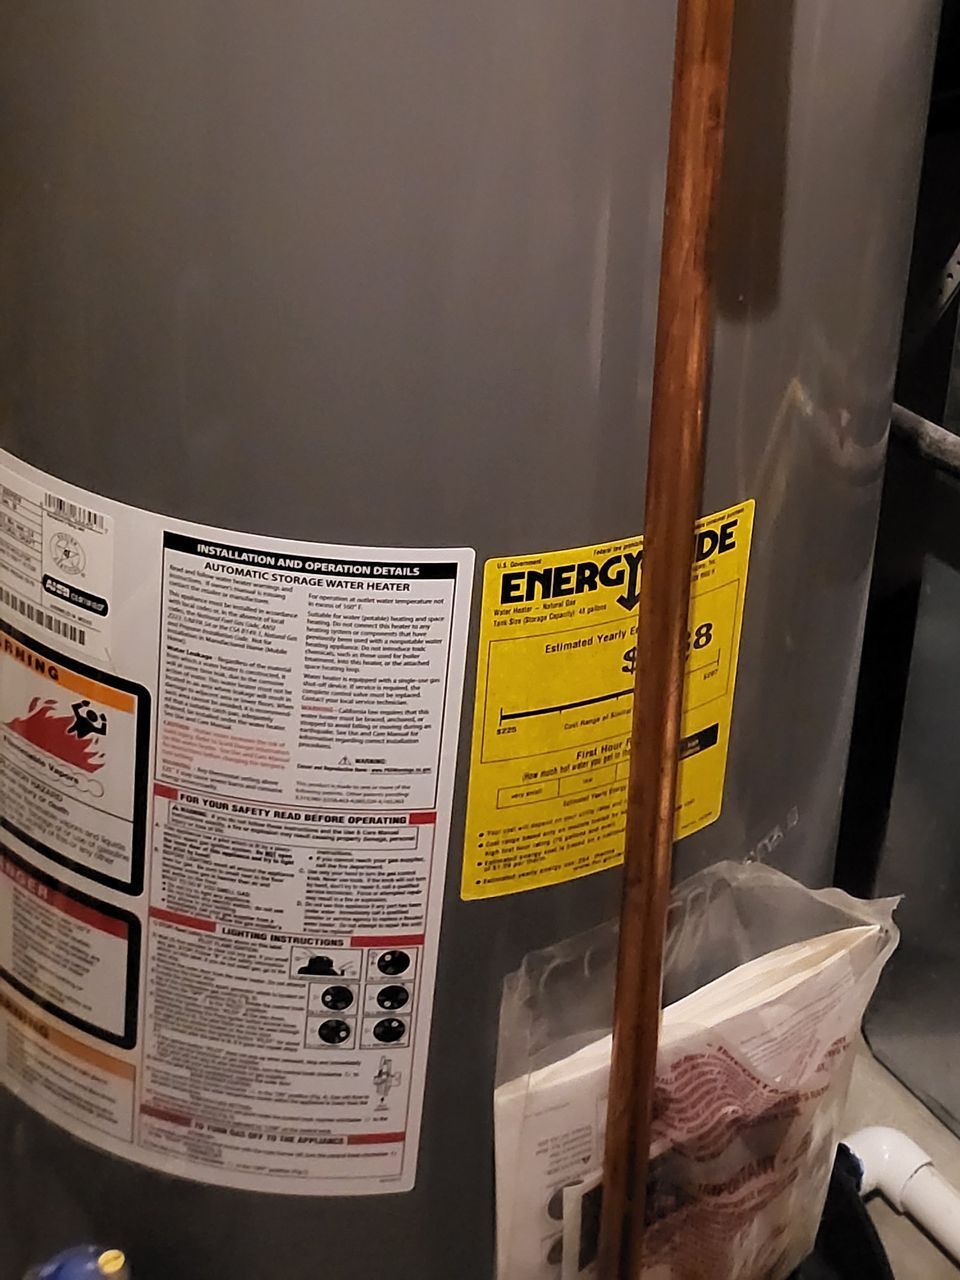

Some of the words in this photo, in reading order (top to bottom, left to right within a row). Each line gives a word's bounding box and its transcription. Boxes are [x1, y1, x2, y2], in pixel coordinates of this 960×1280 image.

[197, 544, 276, 565] INSTALLATION
[277, 557, 302, 569] AND
[305, 561, 372, 576] OPERATION
[374, 566, 420, 576] DETAILS
[204, 562, 269, 581] AUTOMATIC
[272, 573, 324, 587] STORAGE
[326, 580, 364, 590] WATER
[367, 582, 410, 592] HEATER
[494, 608, 511, 616] Water
[513, 606, 532, 615] Heater
[494, 619, 507, 627] Tank
[509, 616, 521, 625] Size
[545, 636, 593, 653] Estimated
[596, 628, 626, 644] Yearly
[576, 748, 597, 759] First
[601, 743, 622, 753] Hour
[180, 793, 199, 805] FOR
[202, 798, 229, 810] YOUR
[232, 804, 271, 817] SAFETY
[273, 811, 301, 820] READ
[304, 813, 344, 824] BEFORE
[348, 815, 407, 824] OPERATING
[222, 927, 267, 941] LIGHTING
[270, 934, 344, 946] INSTRUCTIONS
